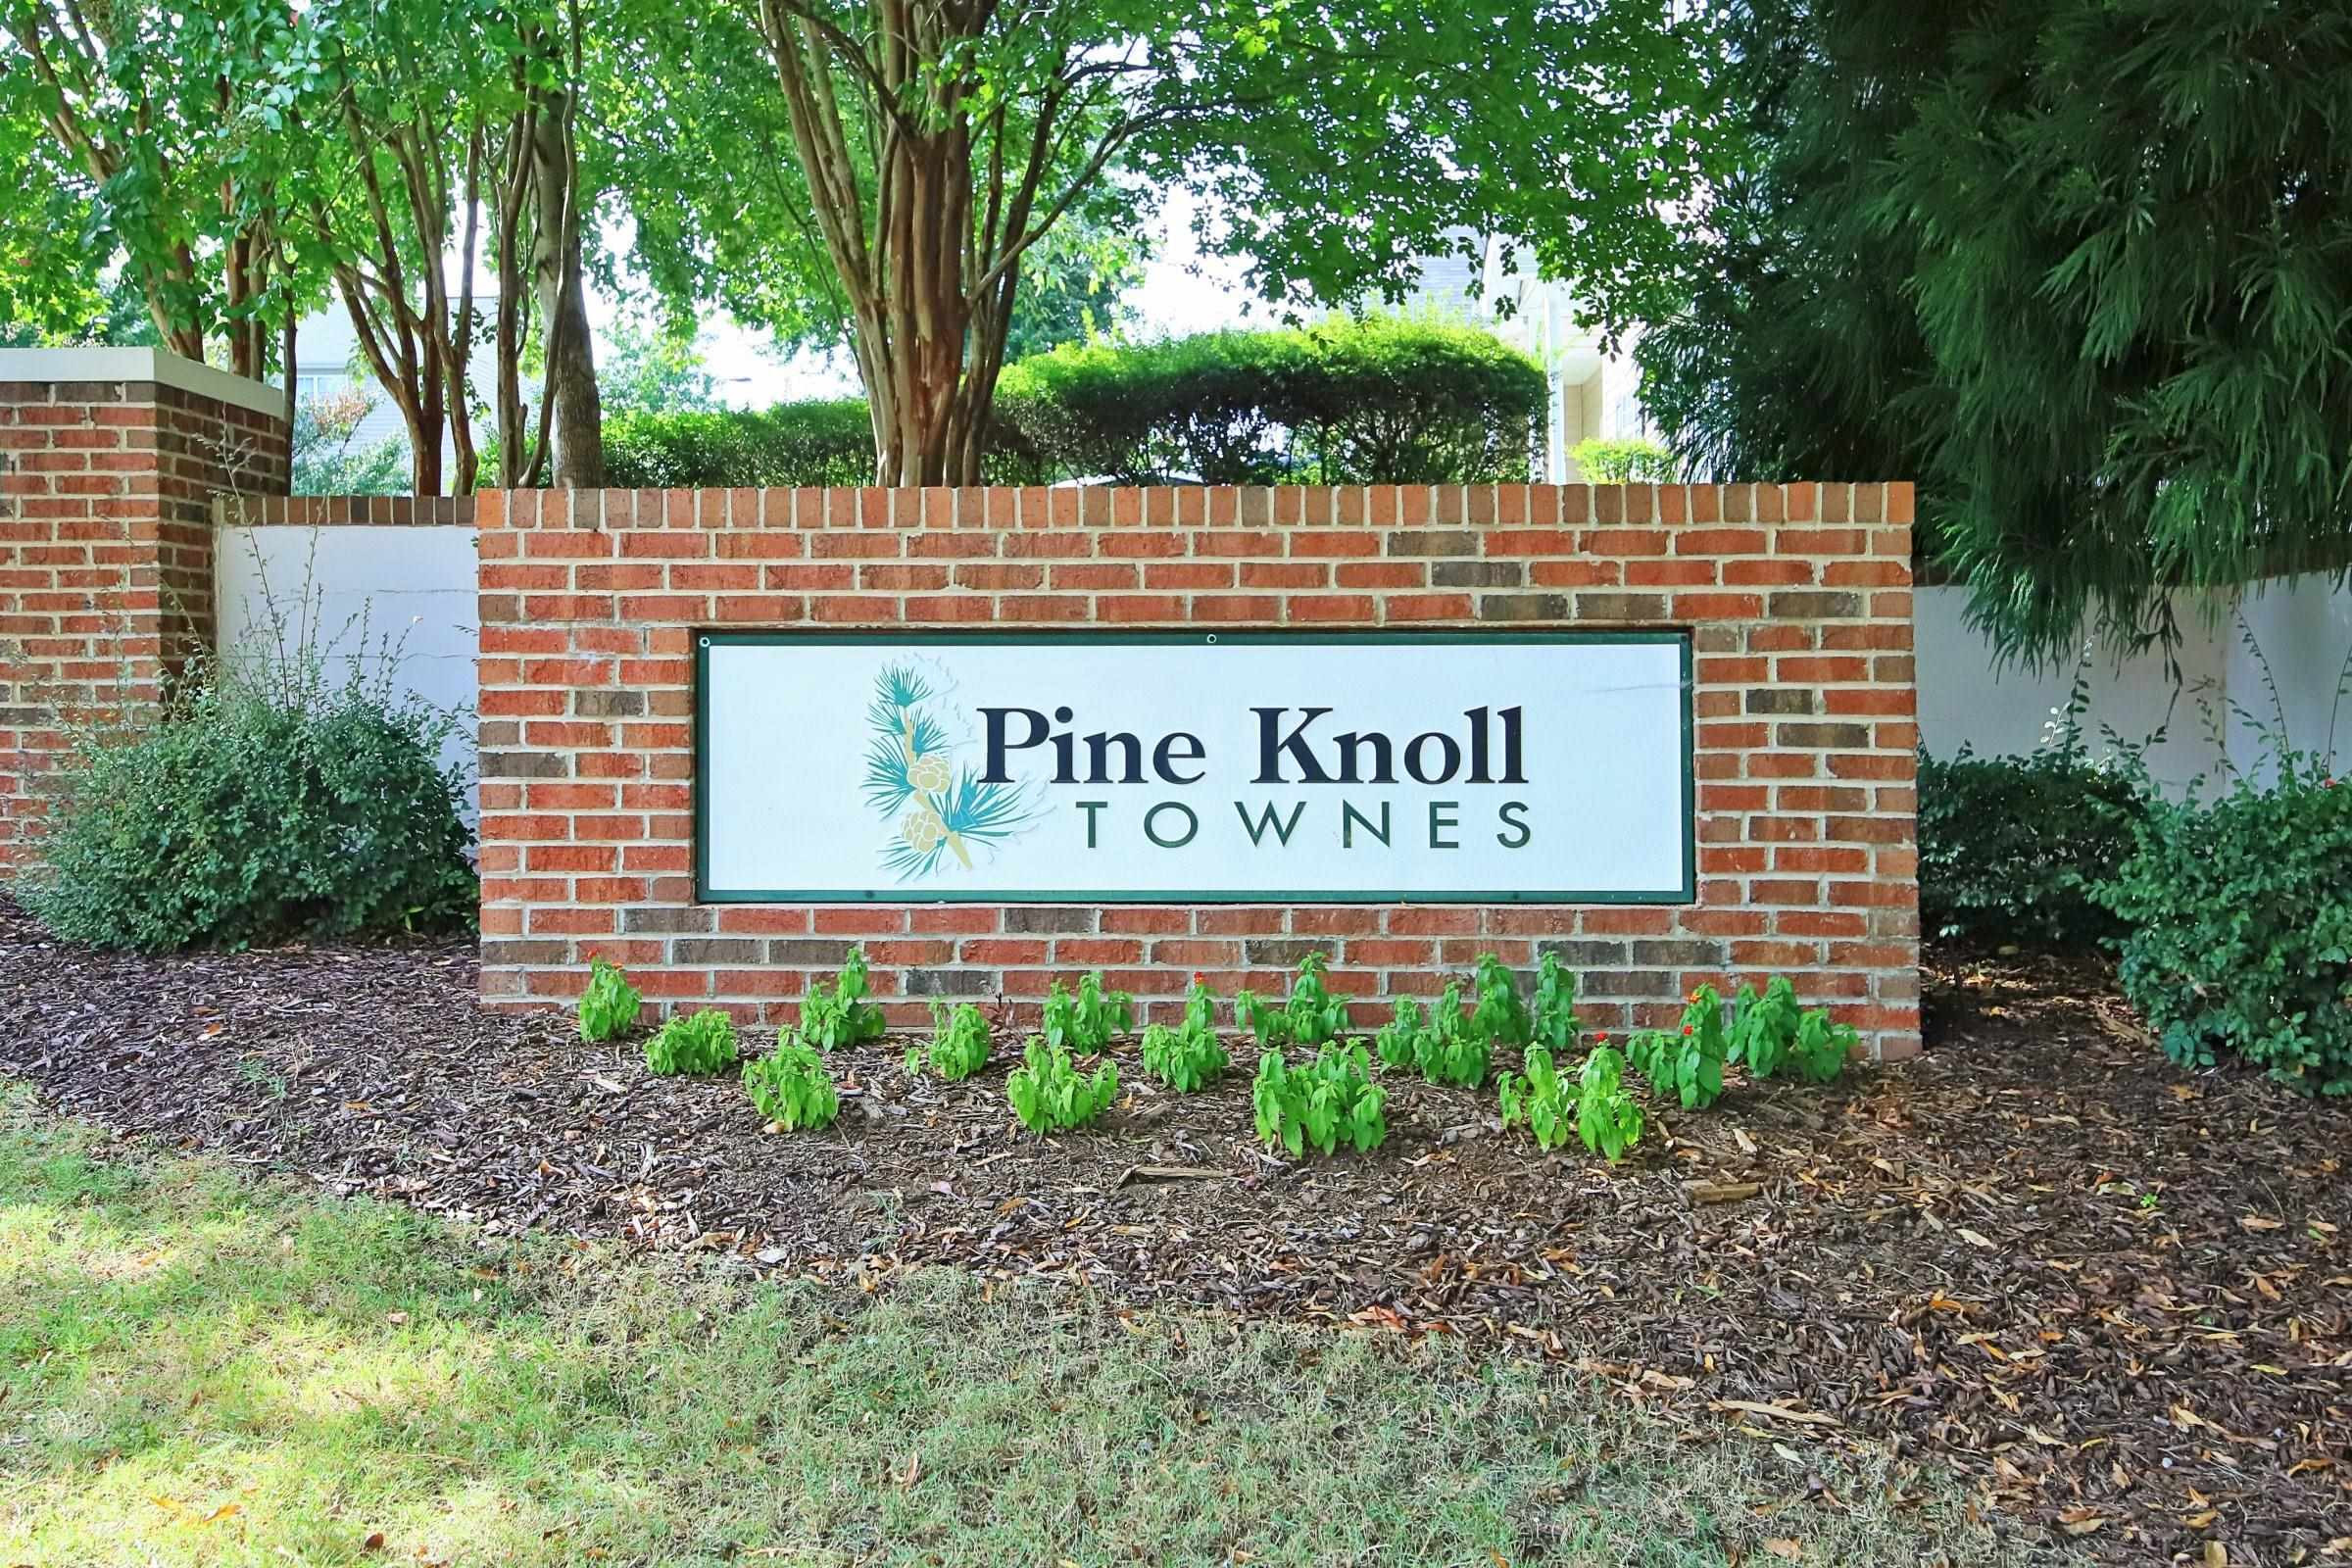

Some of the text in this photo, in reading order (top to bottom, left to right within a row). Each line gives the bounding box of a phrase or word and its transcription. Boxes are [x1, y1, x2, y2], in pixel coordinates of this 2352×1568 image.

[976, 705, 1530, 785] Pine Knoll
[1075, 800, 1532, 850] TOWNES
